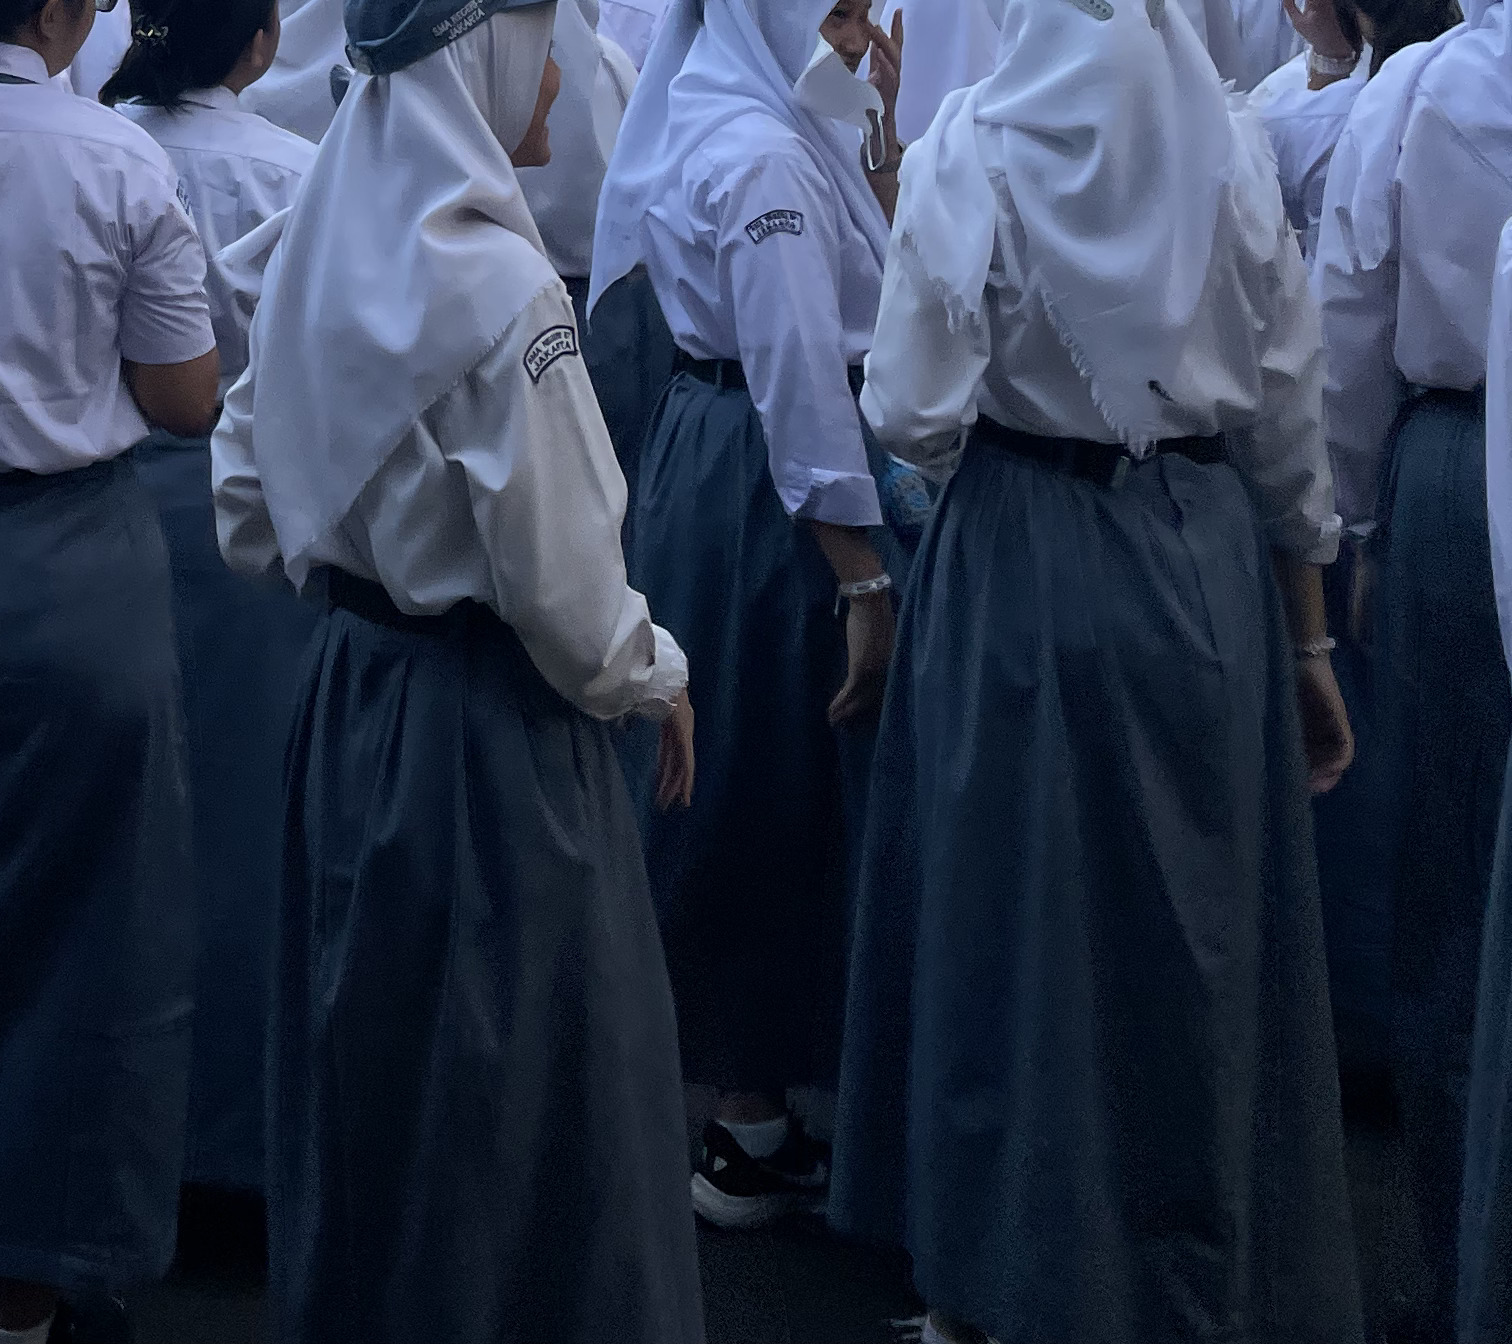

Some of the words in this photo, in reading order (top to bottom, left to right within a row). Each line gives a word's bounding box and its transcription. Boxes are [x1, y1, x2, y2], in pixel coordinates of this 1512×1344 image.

[432, 19, 453, 37] SMA
[448, 7, 486, 40] JAKARTA
[534, 340, 572, 372] JAKARTA
